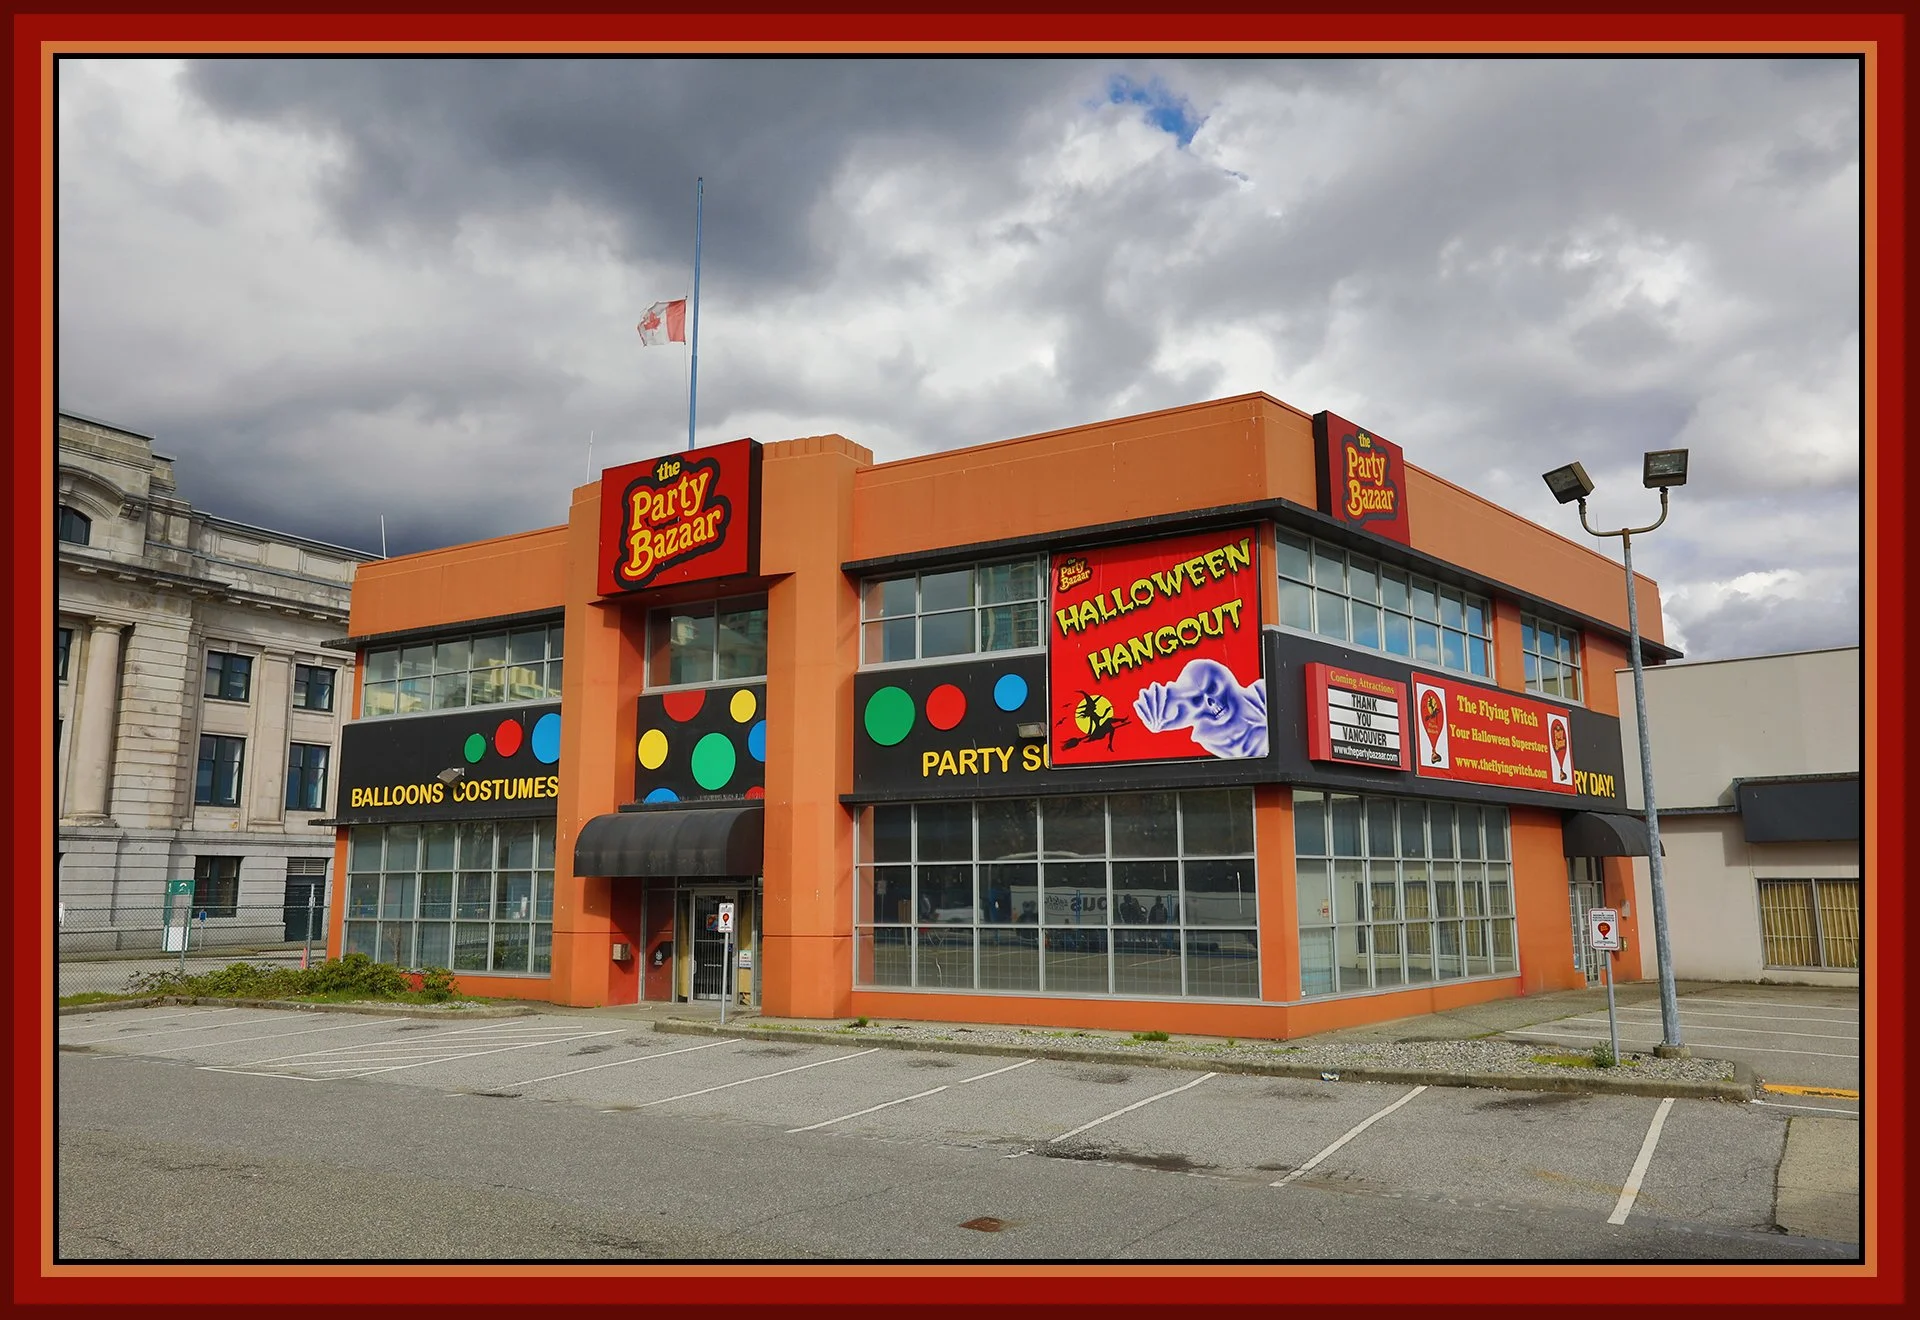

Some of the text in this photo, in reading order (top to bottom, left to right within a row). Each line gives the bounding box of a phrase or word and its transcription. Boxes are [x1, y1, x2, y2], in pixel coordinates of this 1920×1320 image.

[1358, 433, 1371, 448] the
[656, 461, 681, 481] the
[1347, 446, 1385, 487] Party
[631, 471, 709, 531] Party
[1347, 479, 1394, 516] Bazaar
[624, 509, 721, 577] Bazaar
[1060, 560, 1085, 578] Party
[1060, 569, 1091, 590] Bazaar
[1055, 537, 1252, 636] HALLOWEEN
[1088, 598, 1243, 680] HANGOUT
[1330, 670, 1395, 694] Coming Attractions
[1351, 694, 1378, 712] THANK
[1456, 694, 1539, 728] The Flying Witch
[1356, 712, 1372, 727] YOU
[1342, 726, 1387, 747] VANCOUVER
[1450, 723, 1470, 740] Your
[1471, 728, 1511, 748] Halloween
[1511, 735, 1548, 753] Superstore
[922, 745, 1014, 777] PARTY
[1333, 744, 1399, 762] www.thepartybazaar.com
[1455, 756, 1548, 780] www.theflyingwitch.com
[351, 775, 559, 808] BALLOONS COSTUMES
[1589, 772, 1616, 799] DAY!
